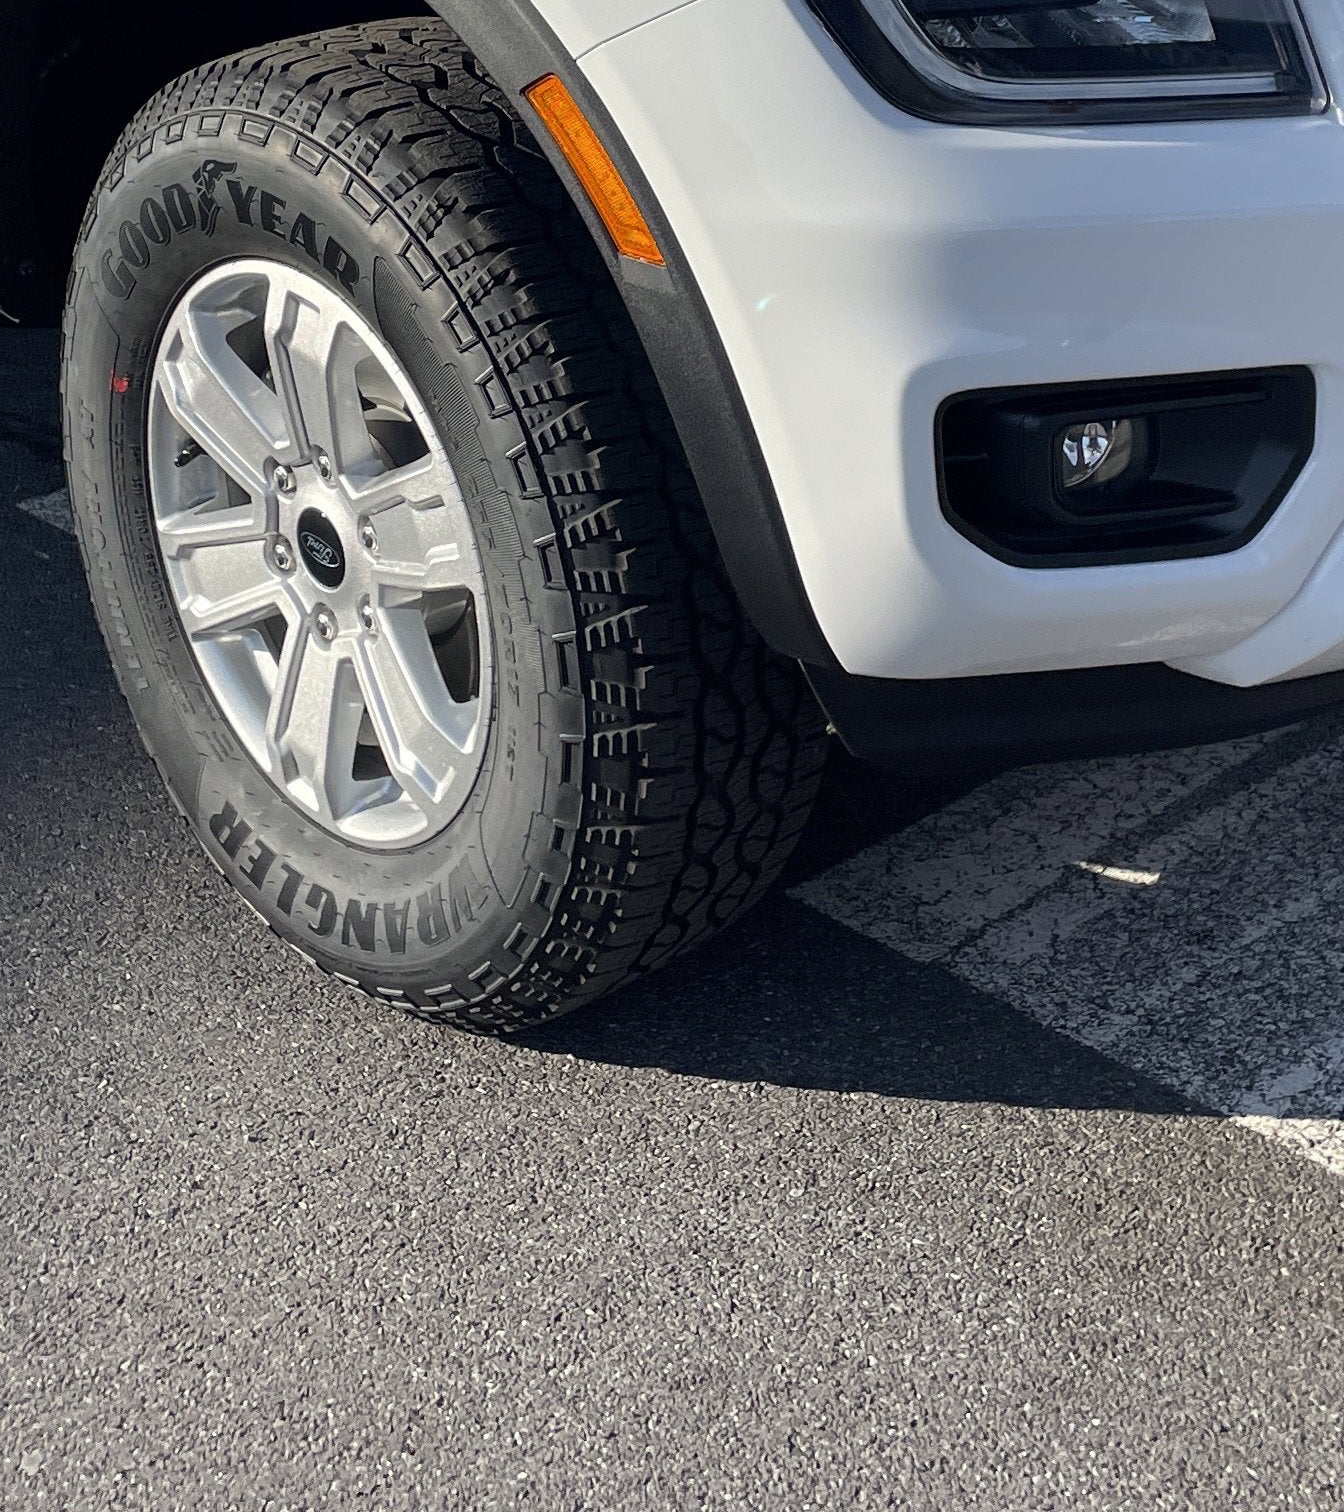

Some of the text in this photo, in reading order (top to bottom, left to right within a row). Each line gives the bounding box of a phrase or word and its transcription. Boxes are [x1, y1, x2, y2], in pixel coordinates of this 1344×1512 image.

[101, 179, 360, 301] GOODYEAR
[306, 536, 332, 563] Ford
[208, 799, 490, 955] WRANGLER
